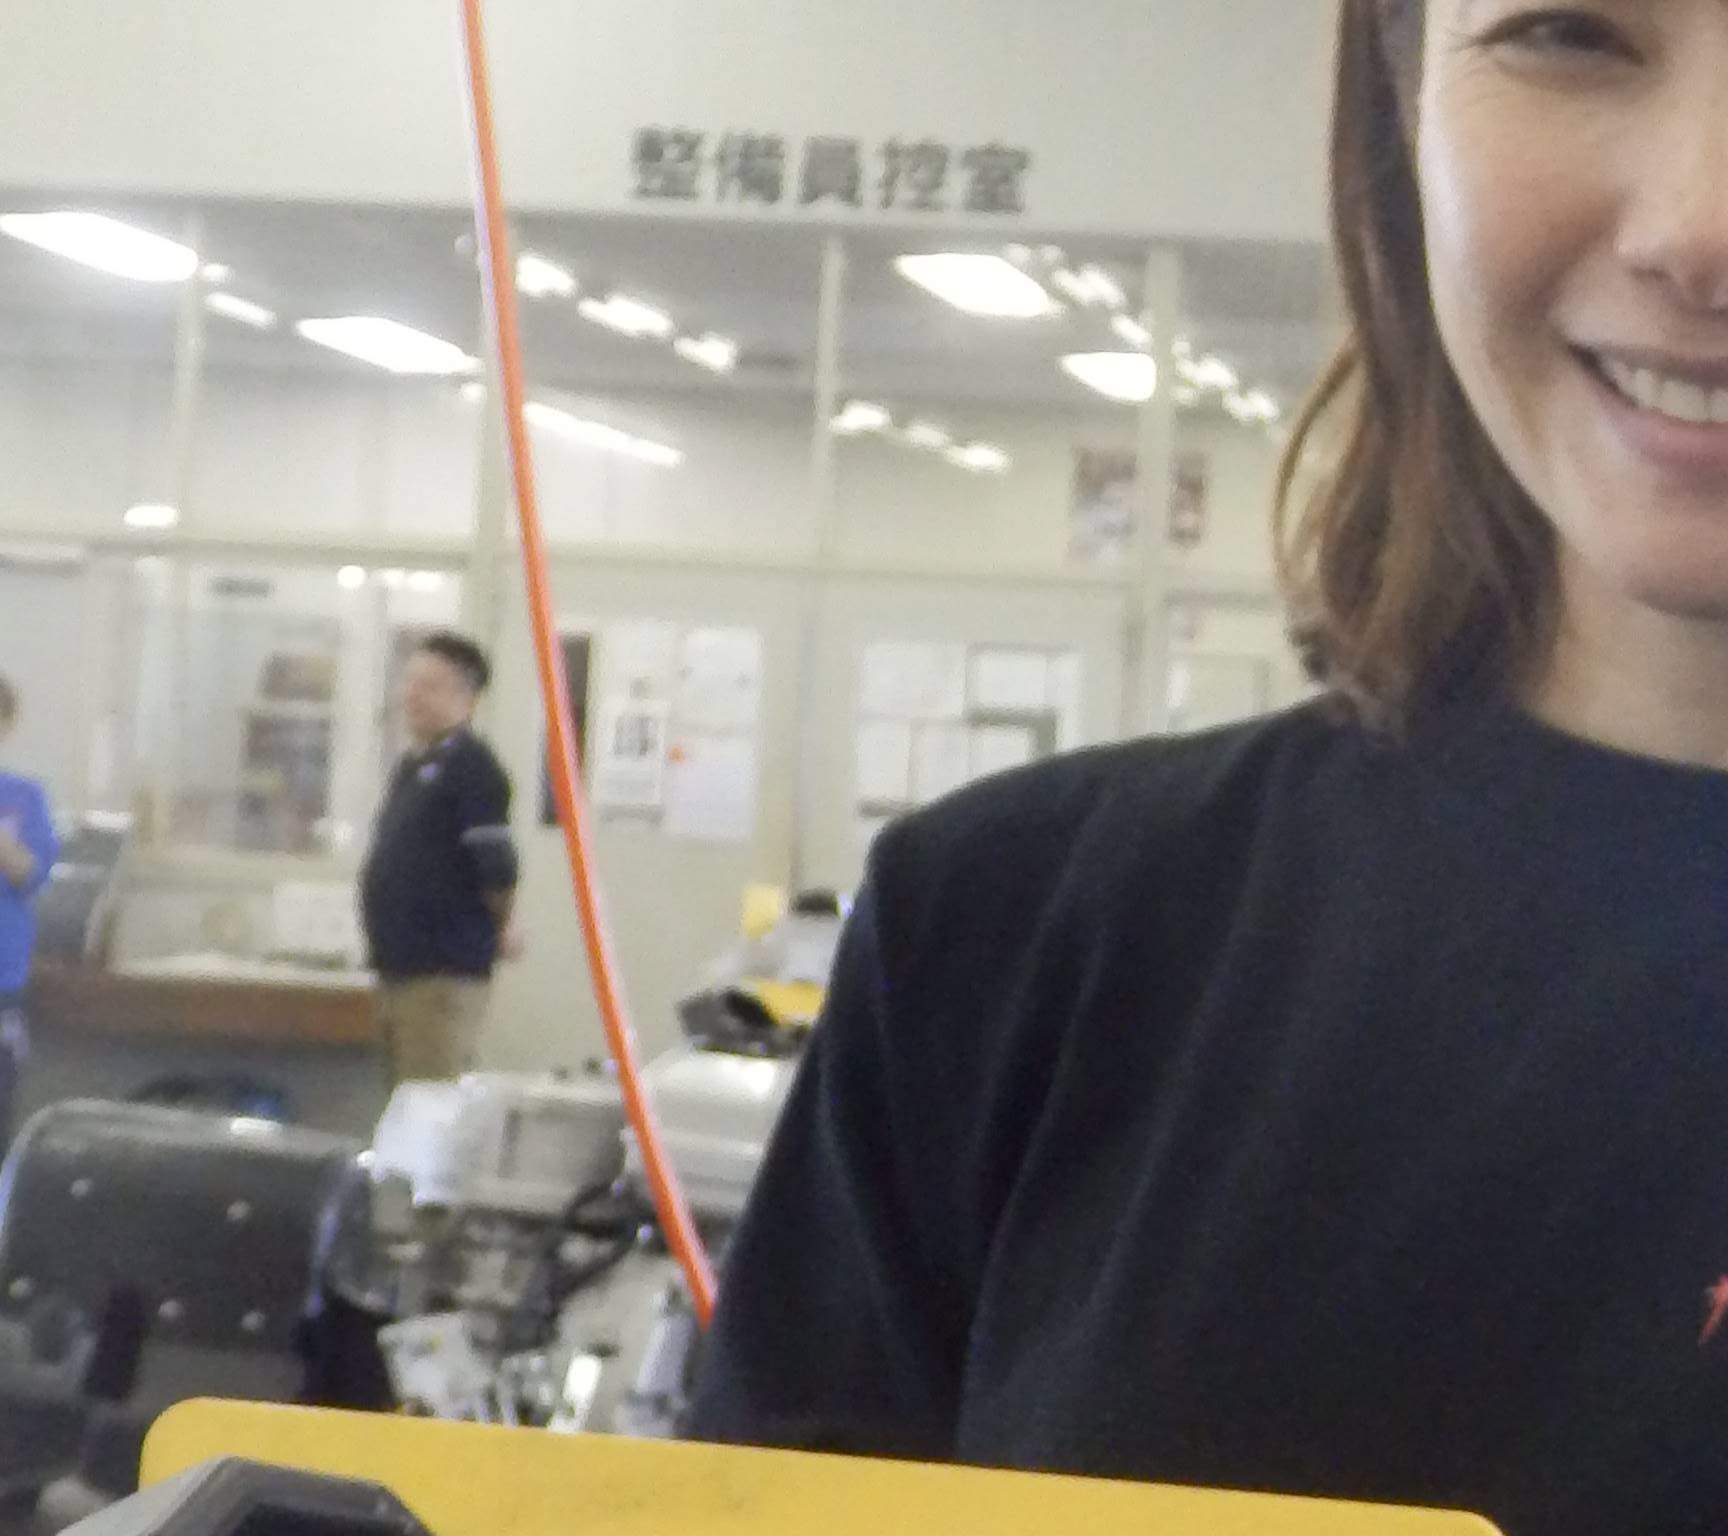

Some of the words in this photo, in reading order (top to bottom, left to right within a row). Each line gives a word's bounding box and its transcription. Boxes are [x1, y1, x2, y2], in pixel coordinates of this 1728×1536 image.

[634, 126, 1031, 213] 整備員控室
